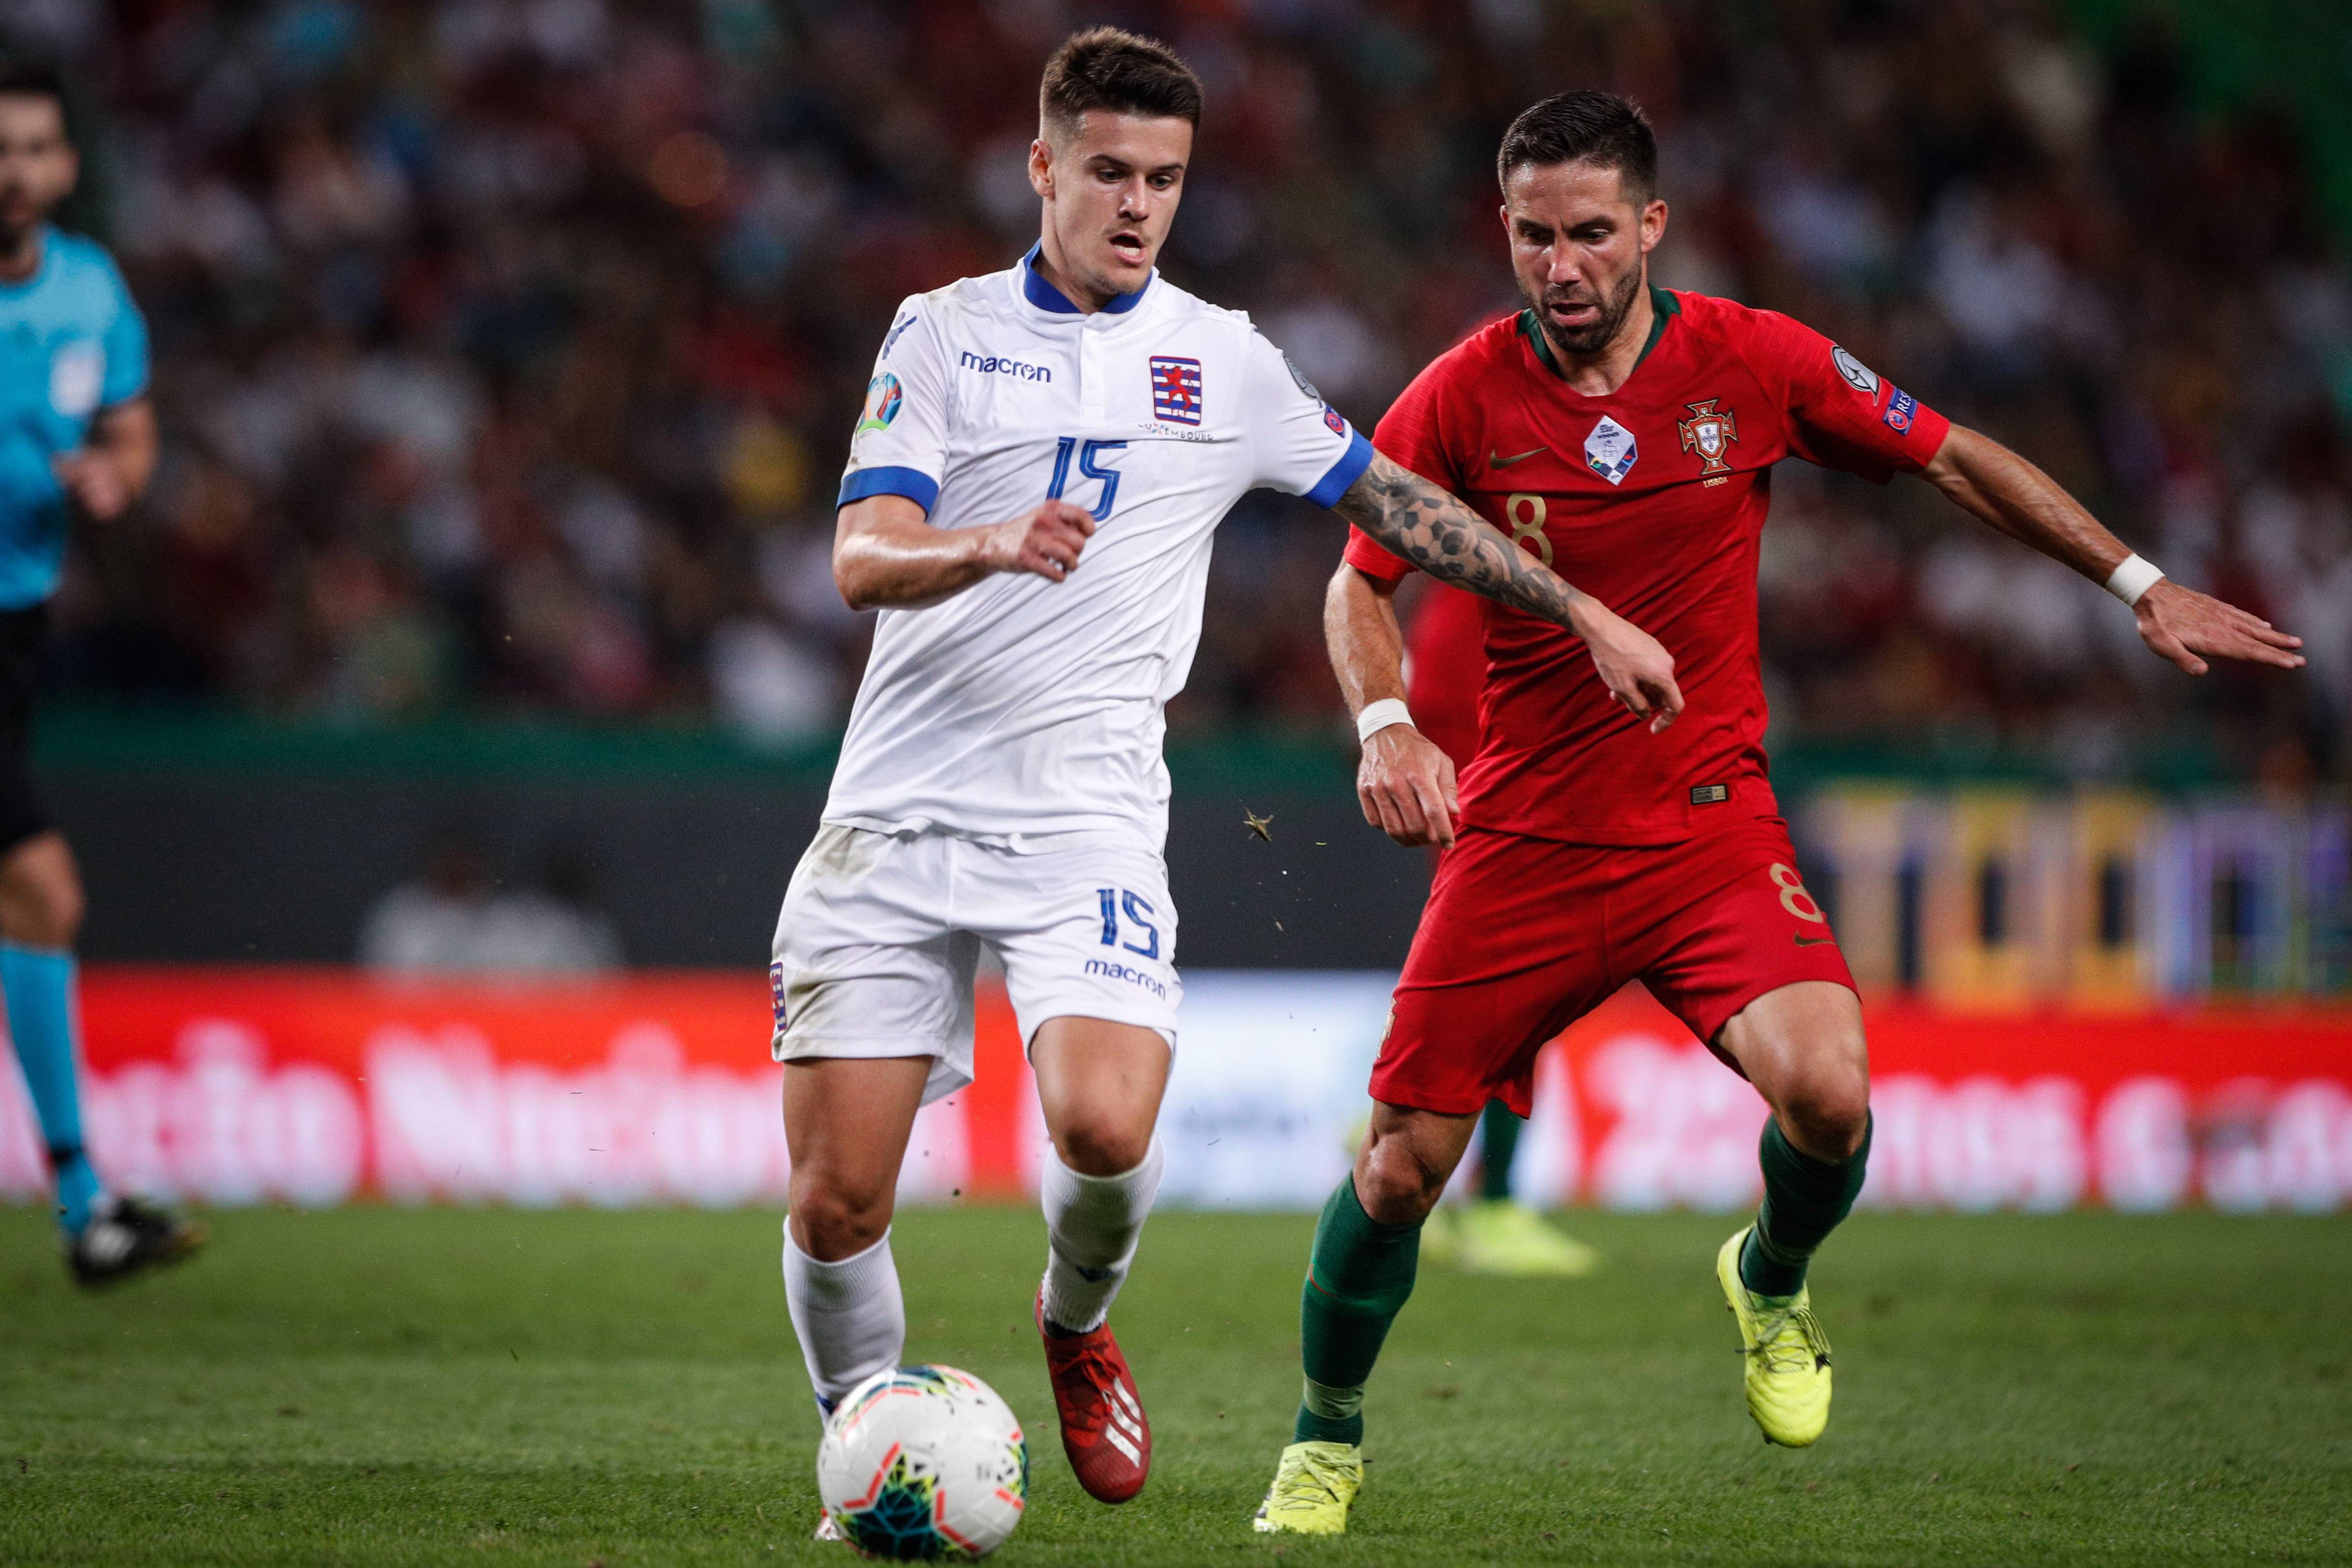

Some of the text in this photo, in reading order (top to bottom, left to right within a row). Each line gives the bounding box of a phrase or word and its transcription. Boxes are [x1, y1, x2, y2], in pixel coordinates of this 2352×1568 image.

[961, 351, 1051, 383] macron
[1896, 389, 1911, 413] RES
[1046, 436, 1128, 522] 15
[1703, 476, 1729, 488] LISBOA
[1507, 493, 1553, 569] 8
[1769, 862, 1824, 924] 8
[1096, 888, 1159, 960] 15
[1085, 959, 1166, 1002] macron
